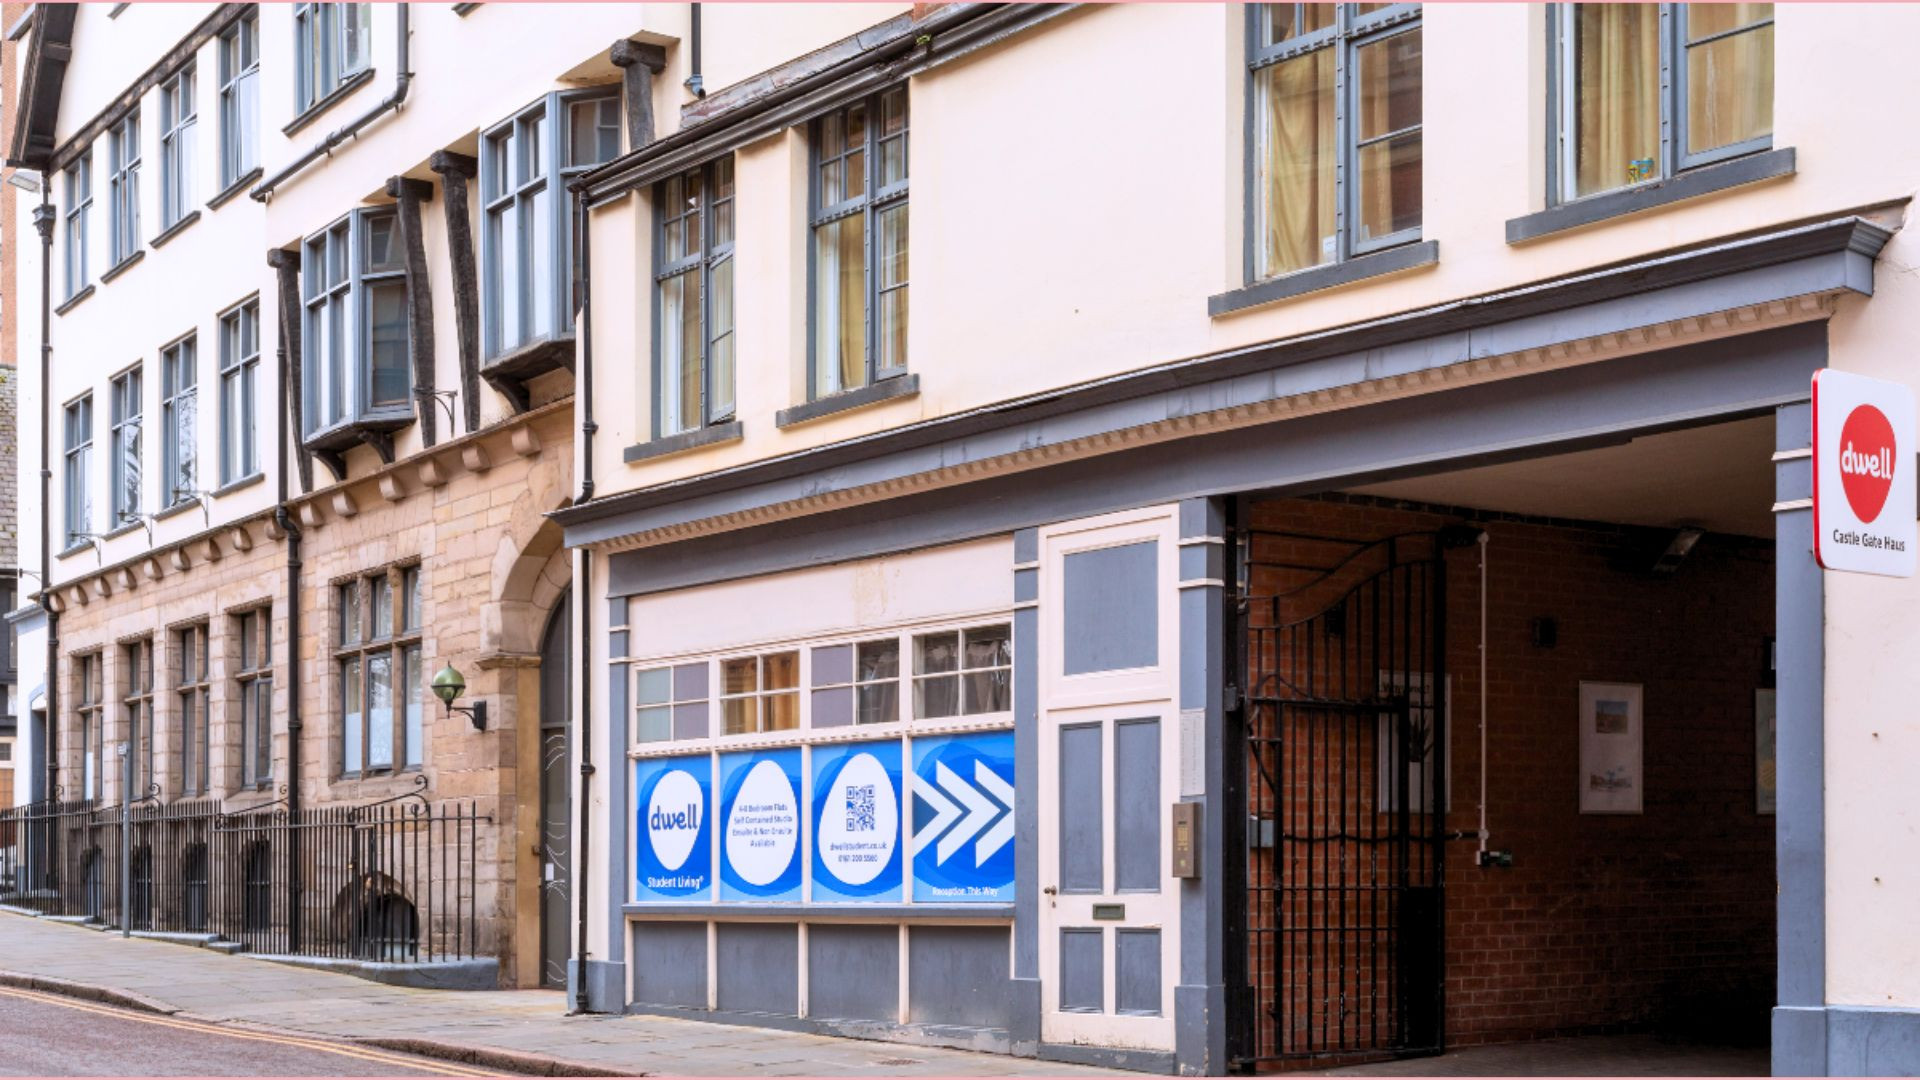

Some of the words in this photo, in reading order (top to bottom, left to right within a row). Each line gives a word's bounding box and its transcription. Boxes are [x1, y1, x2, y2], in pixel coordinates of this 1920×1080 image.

[1841, 441, 1892, 480] dwell
[1833, 529, 1860, 546] Castle
[1861, 532, 1882, 549] Gate
[1884, 535, 1905, 552] Haus
[650, 803, 698, 831] dwell
[647, 876, 676, 888] Student
[932, 886, 966, 896] Reception
[967, 886, 981, 896] This
[982, 886, 1000, 897] Way
